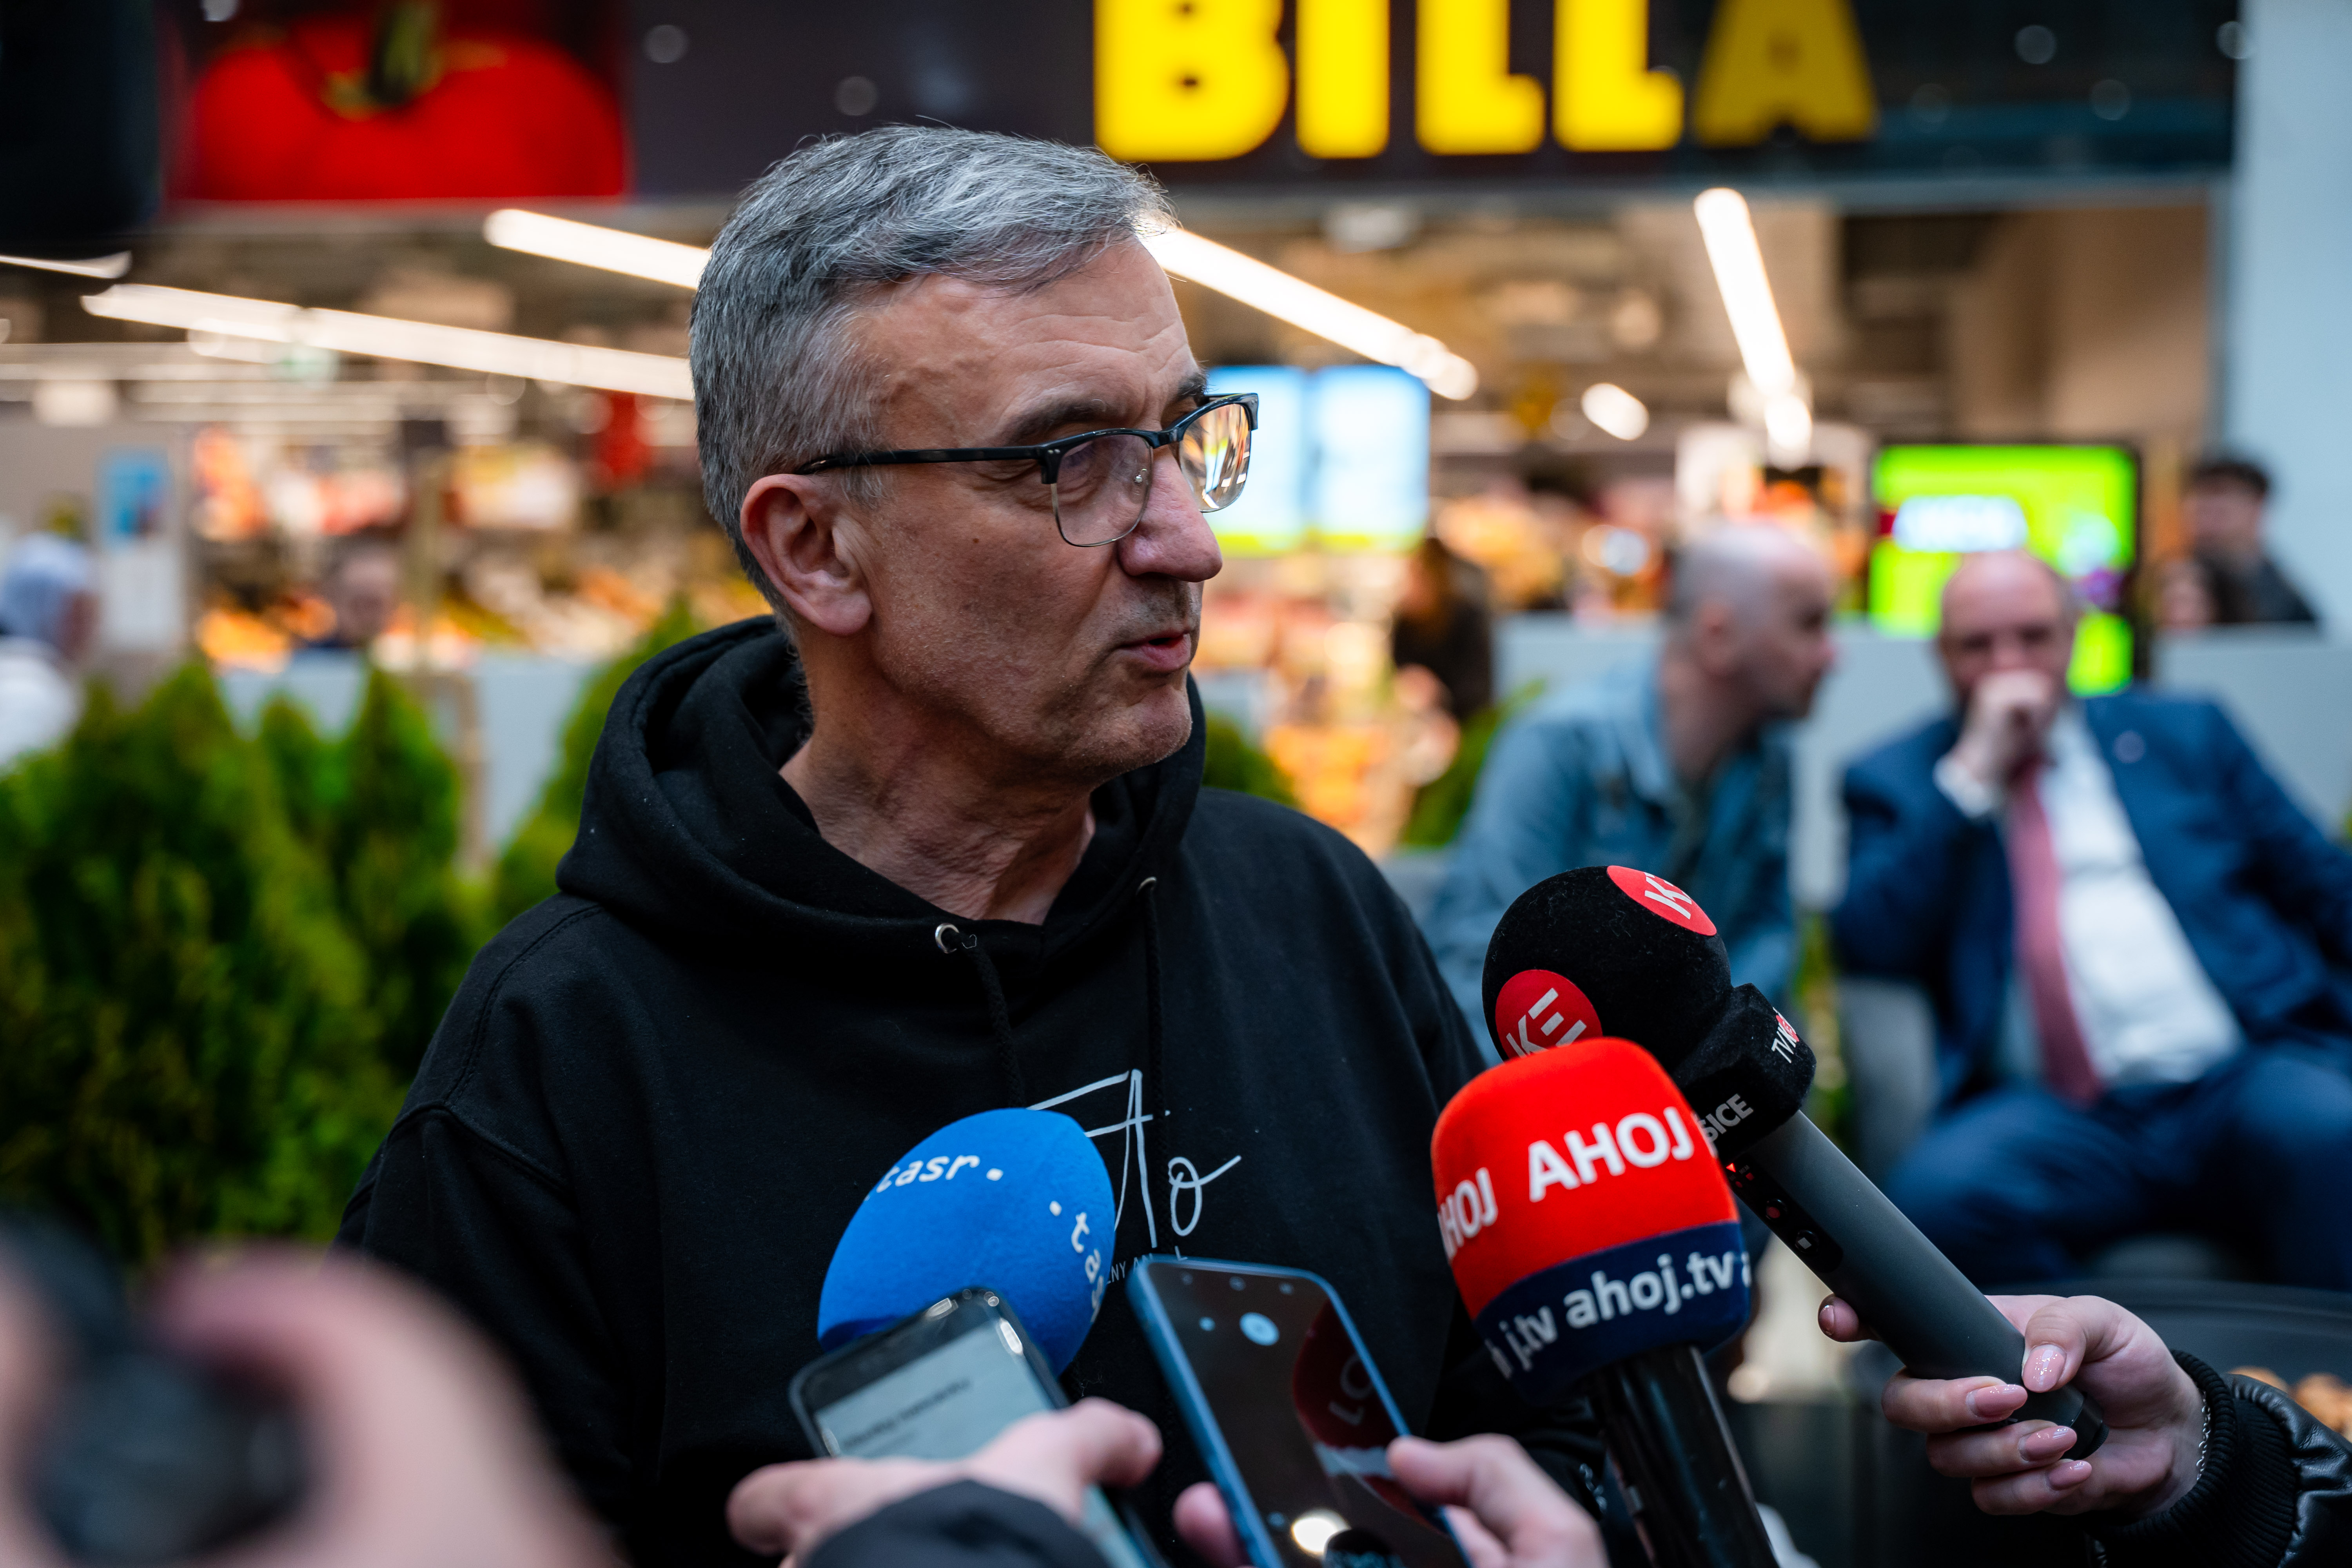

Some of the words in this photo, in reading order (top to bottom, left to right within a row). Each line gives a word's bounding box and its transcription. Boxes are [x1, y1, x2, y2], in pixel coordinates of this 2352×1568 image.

[1094, 0, 1877, 161] BILLA
[1528, 1107, 1694, 1203] AHOJ
[1563, 1251, 1734, 1328] ahoj.tv
